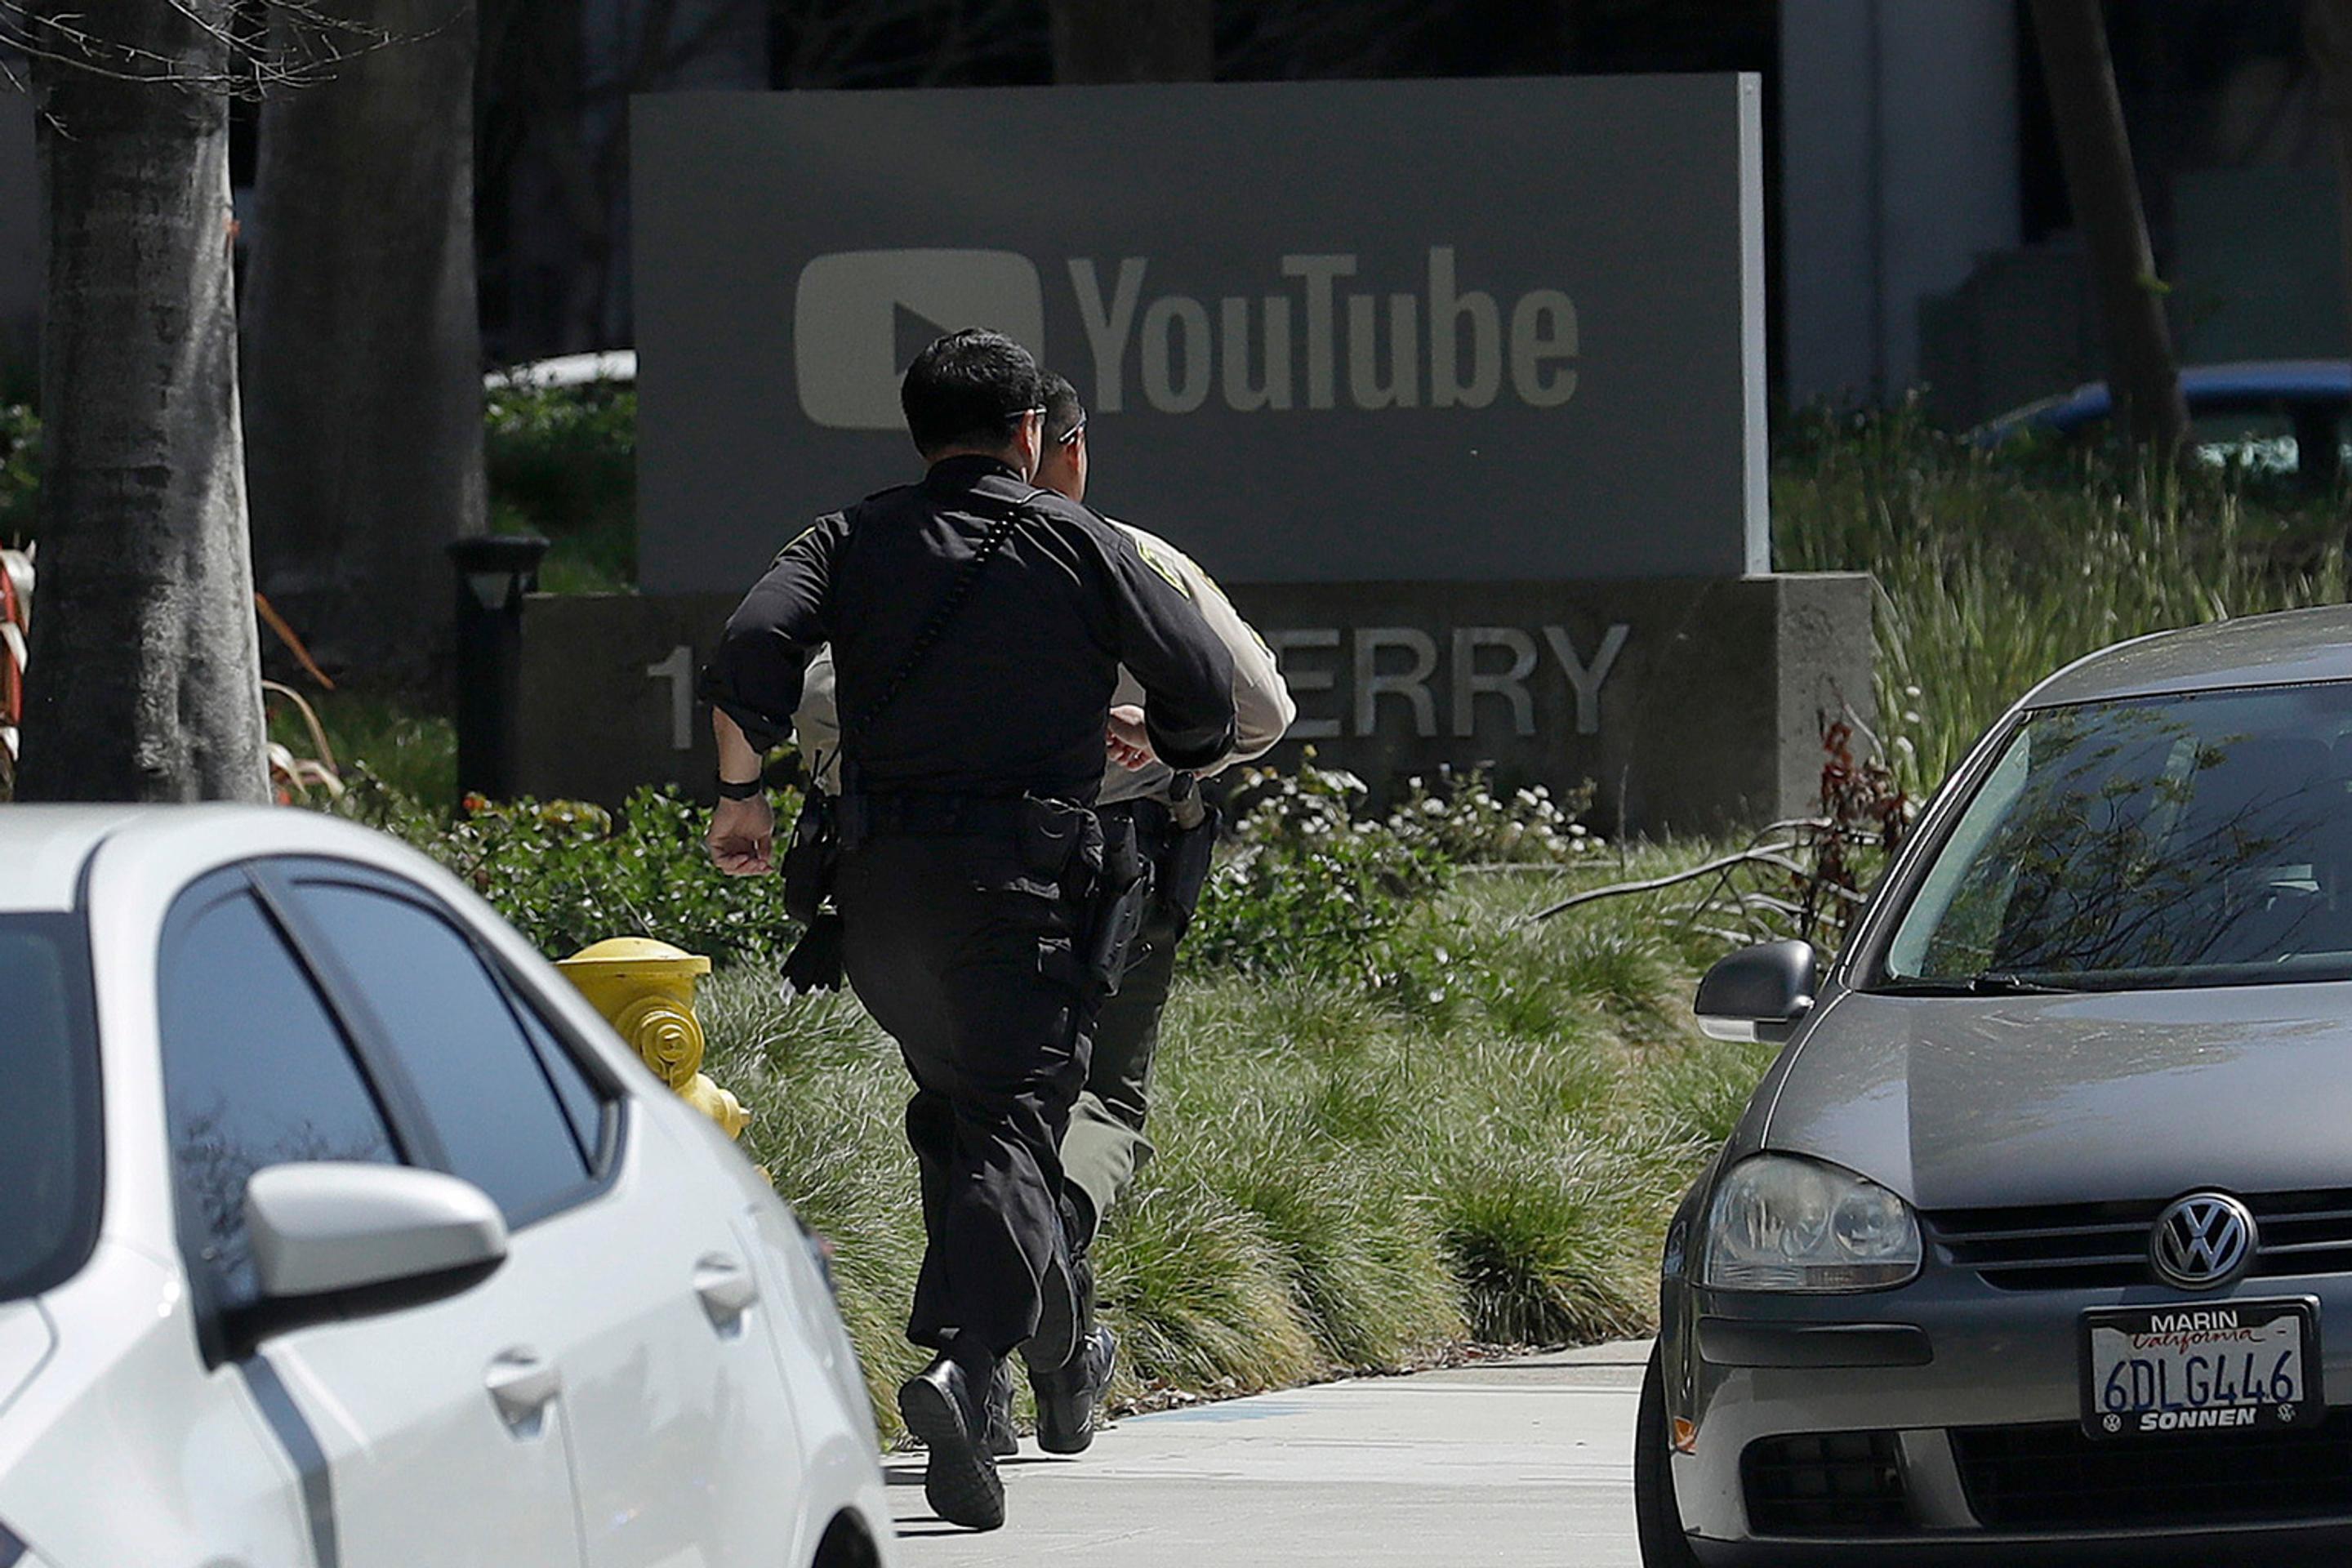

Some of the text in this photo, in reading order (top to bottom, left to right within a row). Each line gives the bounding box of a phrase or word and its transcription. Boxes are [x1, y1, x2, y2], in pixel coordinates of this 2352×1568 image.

[1068, 246, 1579, 414] YouTube
[1271, 623, 1631, 737] ERRY
[2150, 1310, 2238, 1333] MARIN
[2104, 1350, 2293, 1412] 6DLG446
[2139, 1407, 2257, 1432] SONNEN
